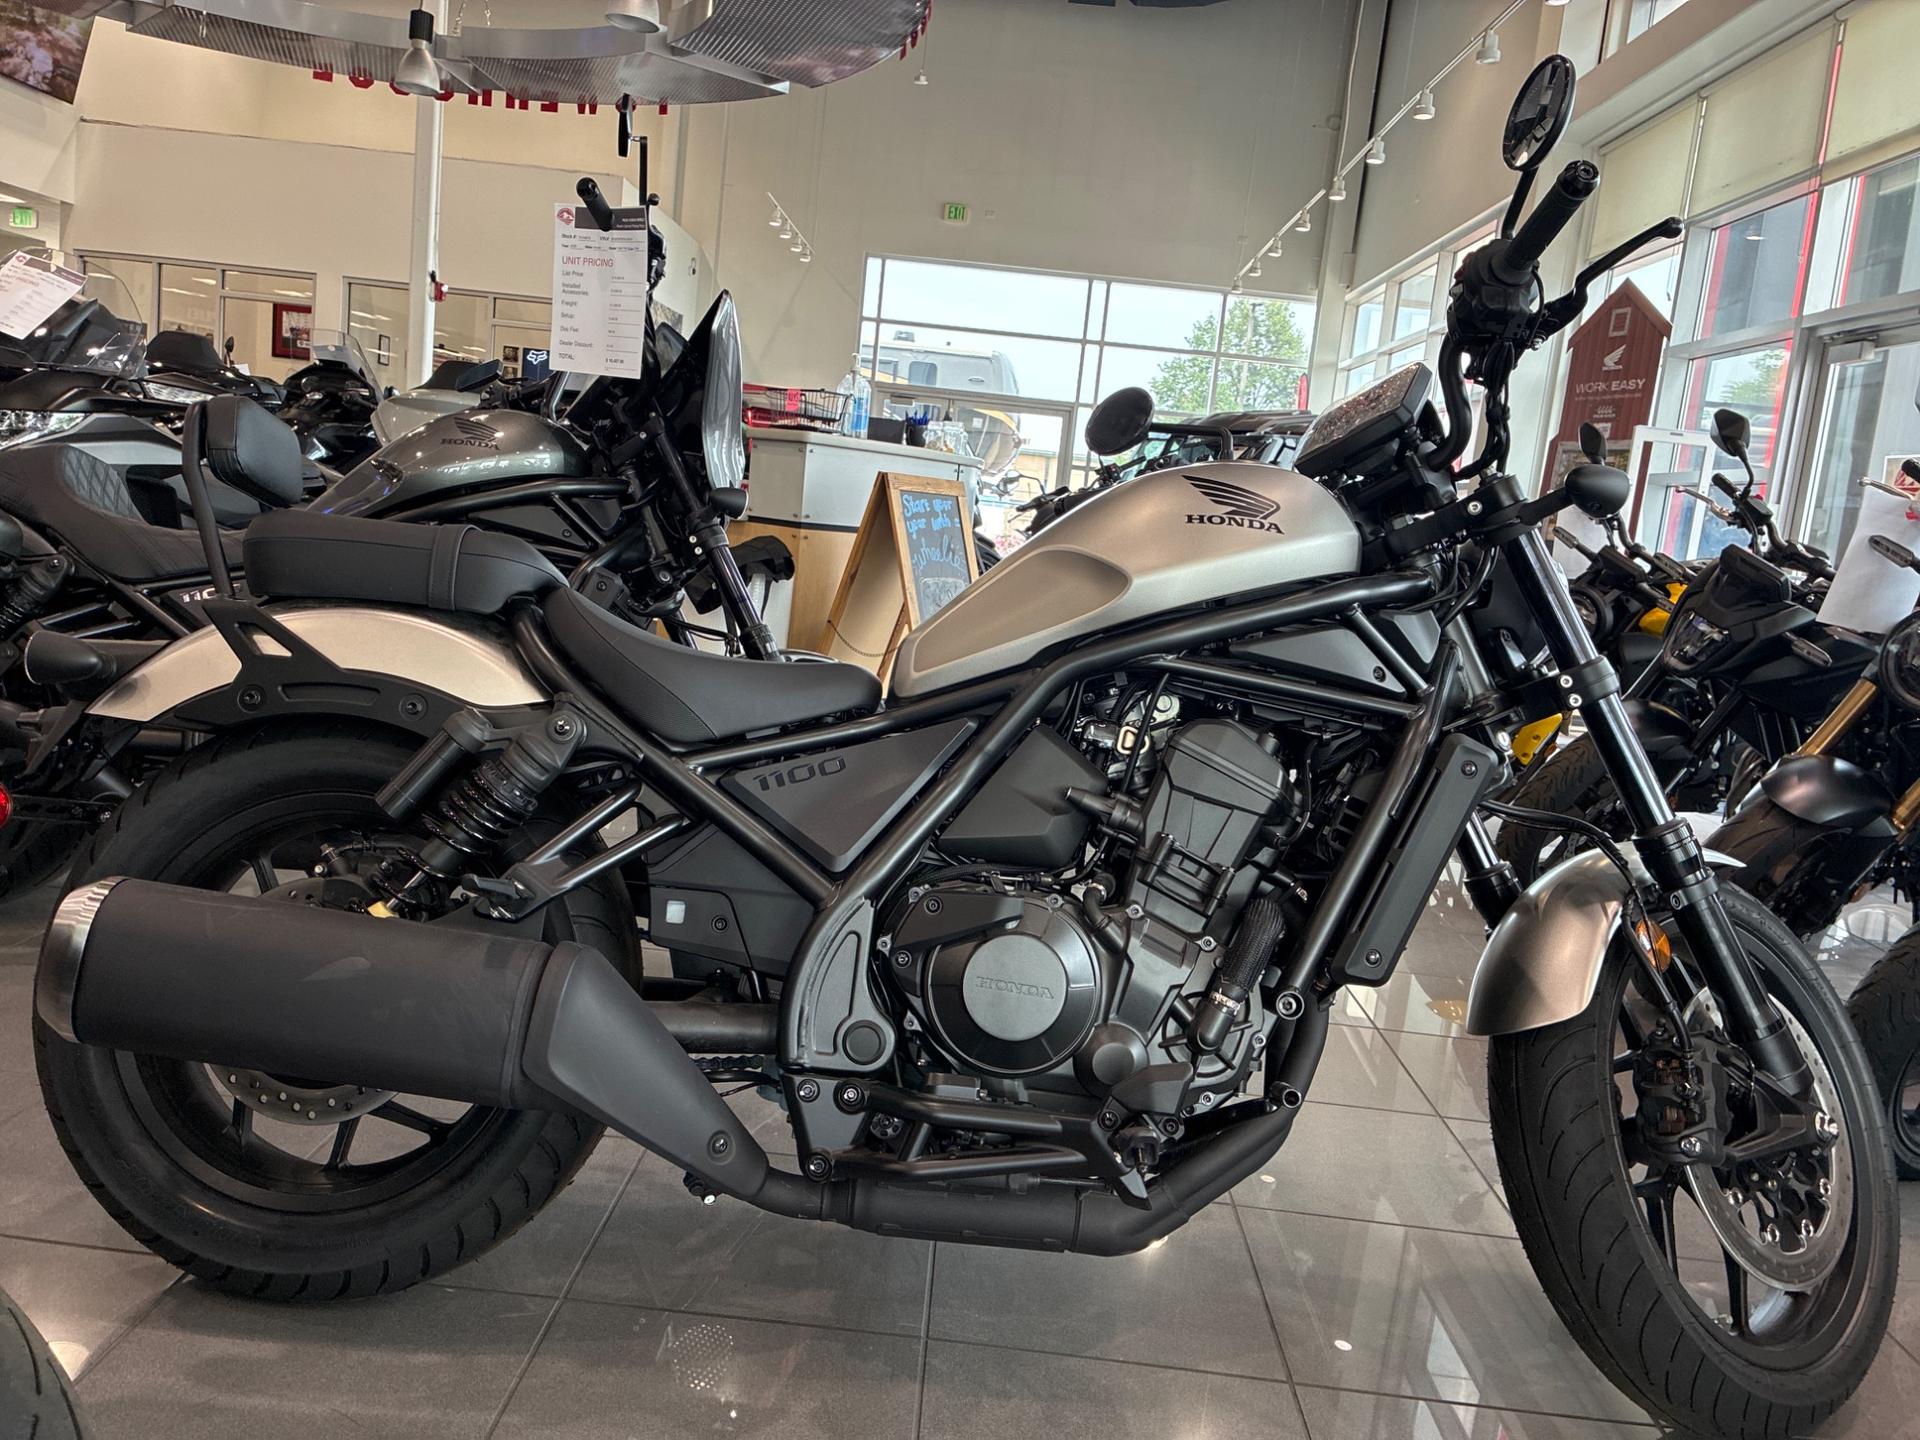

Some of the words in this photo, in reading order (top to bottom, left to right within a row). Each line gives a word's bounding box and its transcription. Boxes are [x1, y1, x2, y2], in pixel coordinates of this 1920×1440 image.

[948, 205, 966, 221] EXIT
[561, 256, 581, 265] UNIT
[582, 257, 614, 268] PRICING
[1575, 381, 1609, 393] WORK
[1611, 378, 1646, 391] EASY
[440, 438, 501, 451] HONDA
[902, 494, 930, 517] Start
[1185, 514, 1286, 535] HONDA
[752, 755, 847, 792] 1100
[975, 975, 1055, 1000] HONDA
